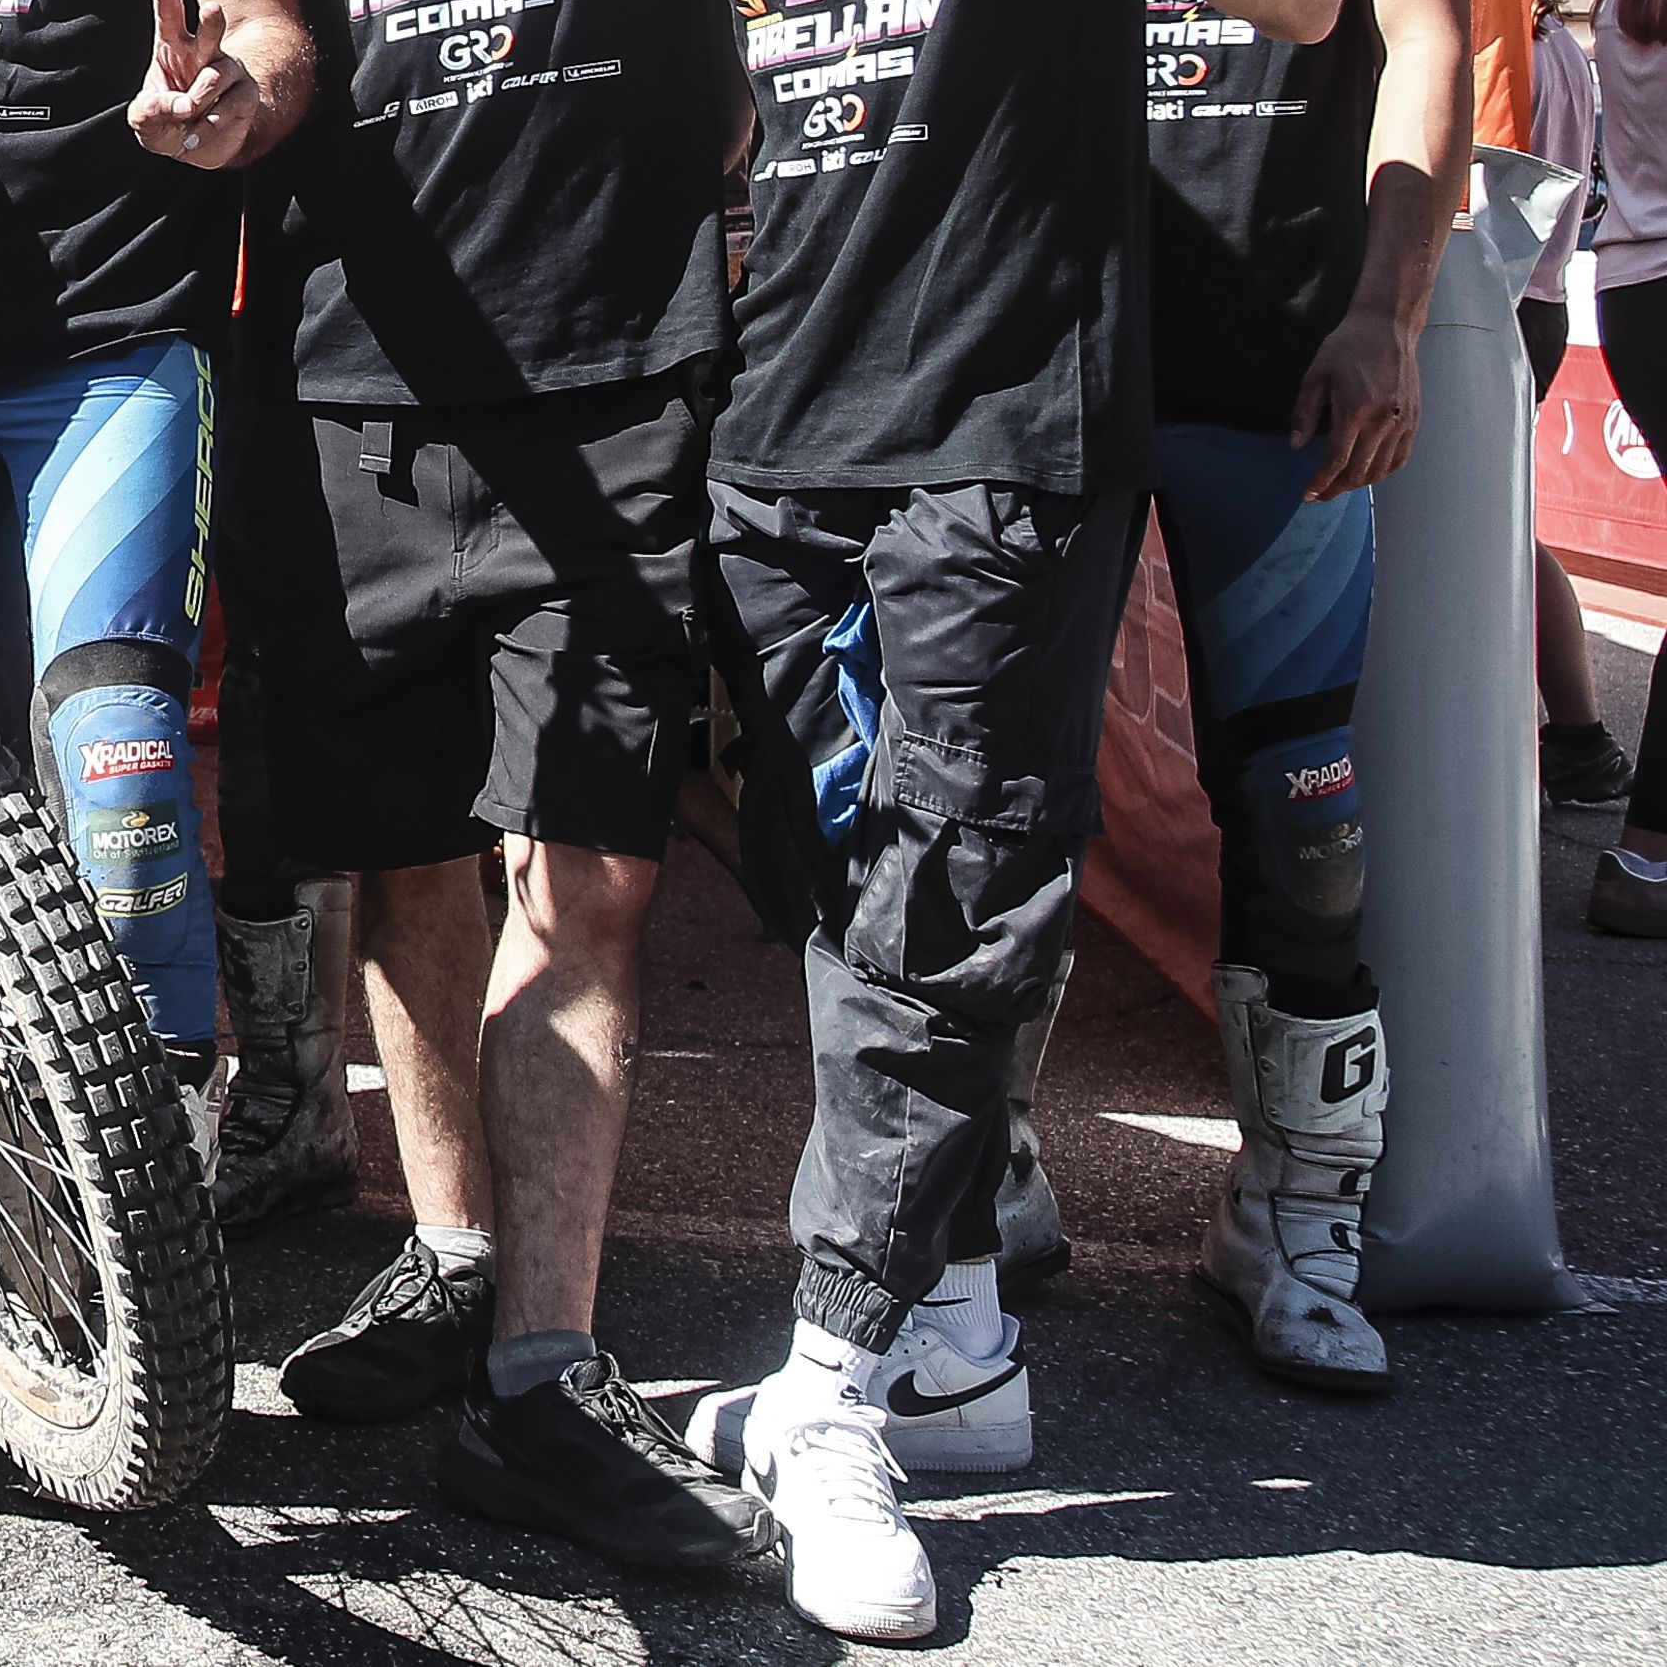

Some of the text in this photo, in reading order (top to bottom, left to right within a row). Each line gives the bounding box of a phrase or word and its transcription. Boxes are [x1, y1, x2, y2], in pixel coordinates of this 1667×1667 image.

[438, 26, 517, 71] GRO
[773, 47, 913, 104] COMAS
[803, 94, 866, 139] GRO
[79, 739, 173, 777] XRADICAL
[107, 761, 171, 775] SUPER GASKETS
[93, 821, 179, 850] MOTOREX
[93, 838, 180, 860] Oil of Switzerland
[98, 881, 185, 914] GALFER
